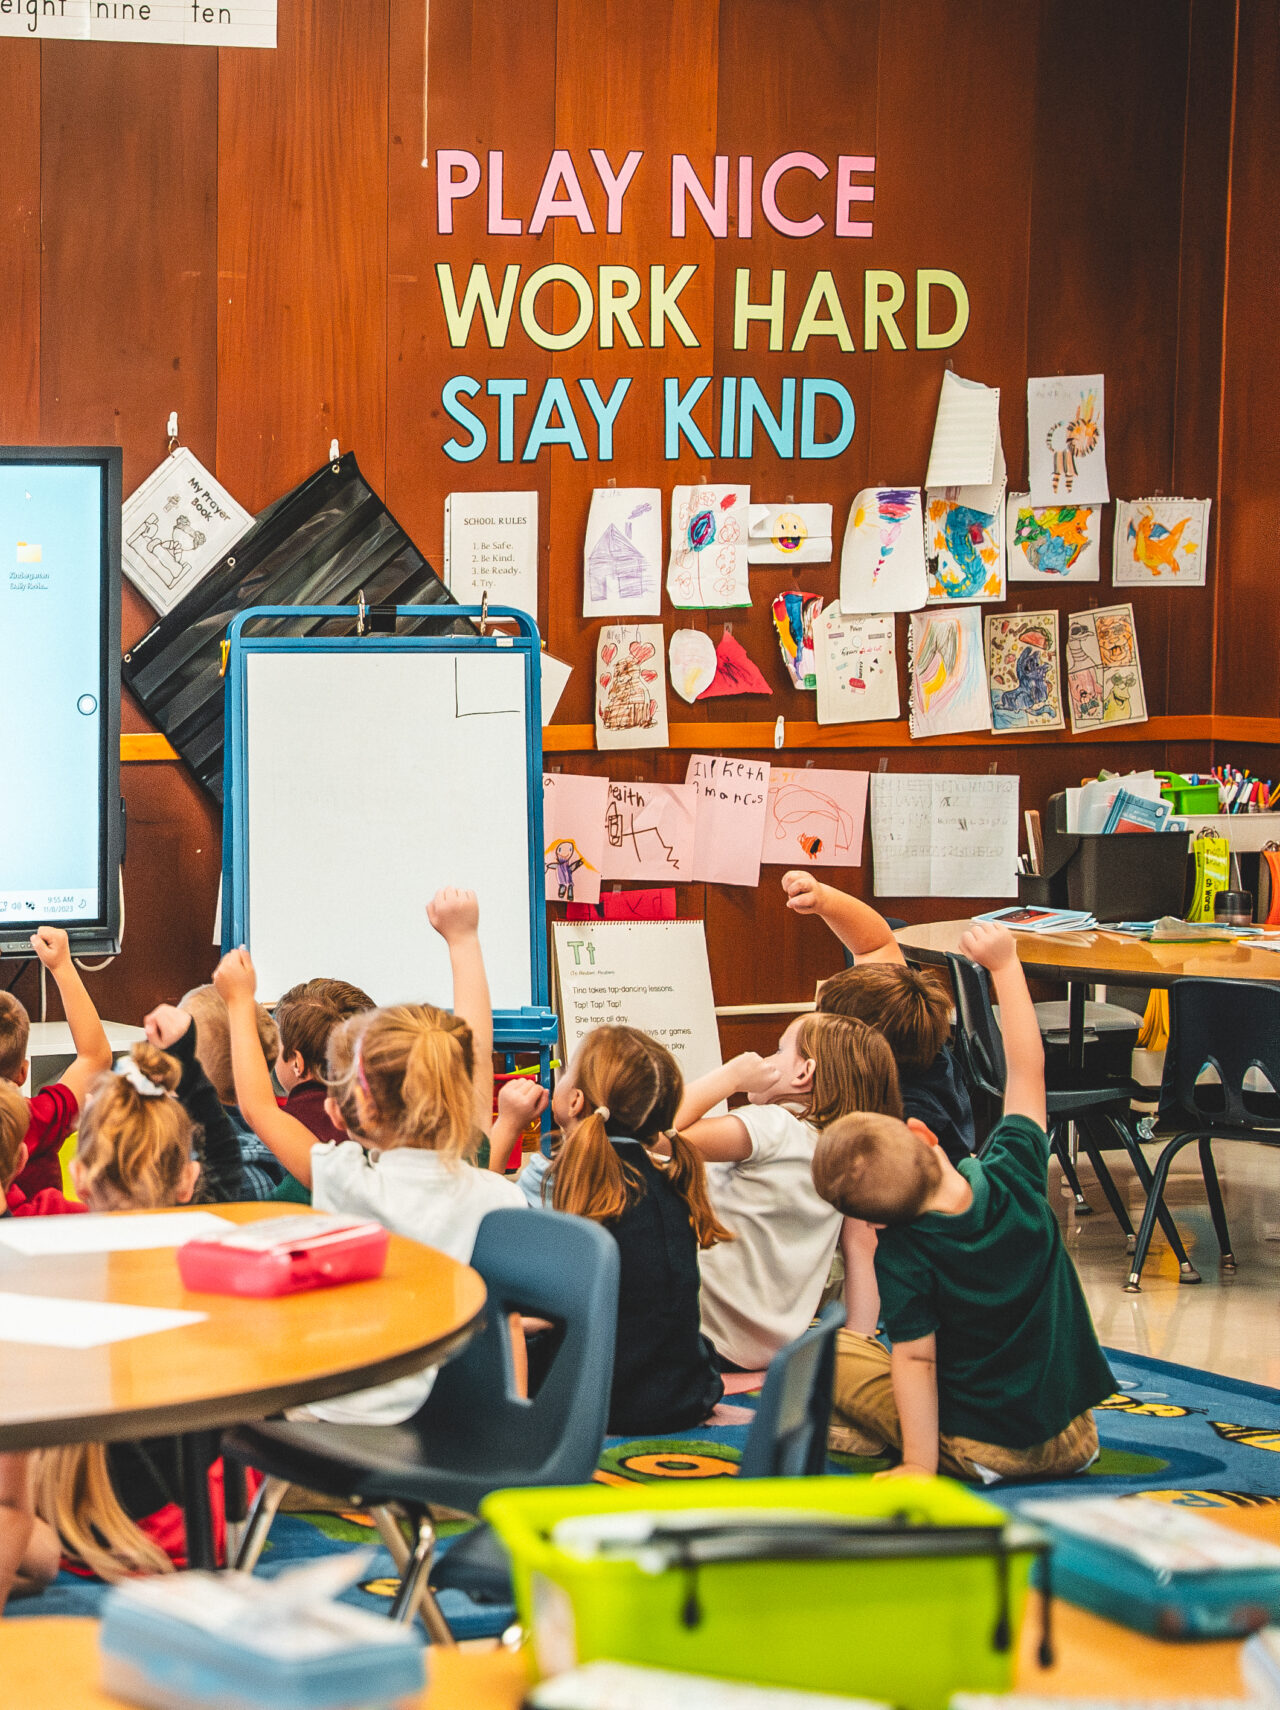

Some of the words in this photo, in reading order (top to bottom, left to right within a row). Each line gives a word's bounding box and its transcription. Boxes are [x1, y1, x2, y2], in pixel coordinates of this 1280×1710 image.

[97, 0, 151, 20] nine
[192, 0, 231, 24] ten
[435, 149, 644, 235] PLAY
[671, 151, 877, 239] NICE
[434, 263, 701, 351] WORK
[733, 268, 971, 352] HARD
[441, 375, 632, 463] STAY
[664, 376, 856, 460] KIND
[188, 477, 204, 494] My
[201, 490, 231, 522] Prayer
[190, 497, 214, 522] Book
[464, 517, 496, 525] SCHOOL
[498, 517, 527, 525] RULES
[481, 542, 490, 550] Be
[492, 541, 514, 550] Safe.
[492, 554, 515, 562] Kind.
[492, 566, 521, 576] Ready.
[480, 580, 496, 588] Try.
[567, 941, 596, 965] Tt
[588, 986, 607, 994] takes
[574, 1001, 588, 1009] Tap!
[591, 1000, 605, 1009] Tap!
[607, 1000, 622, 1008] Tap!
[575, 1016, 589, 1024] She
[590, 1016, 605, 1024] taps
